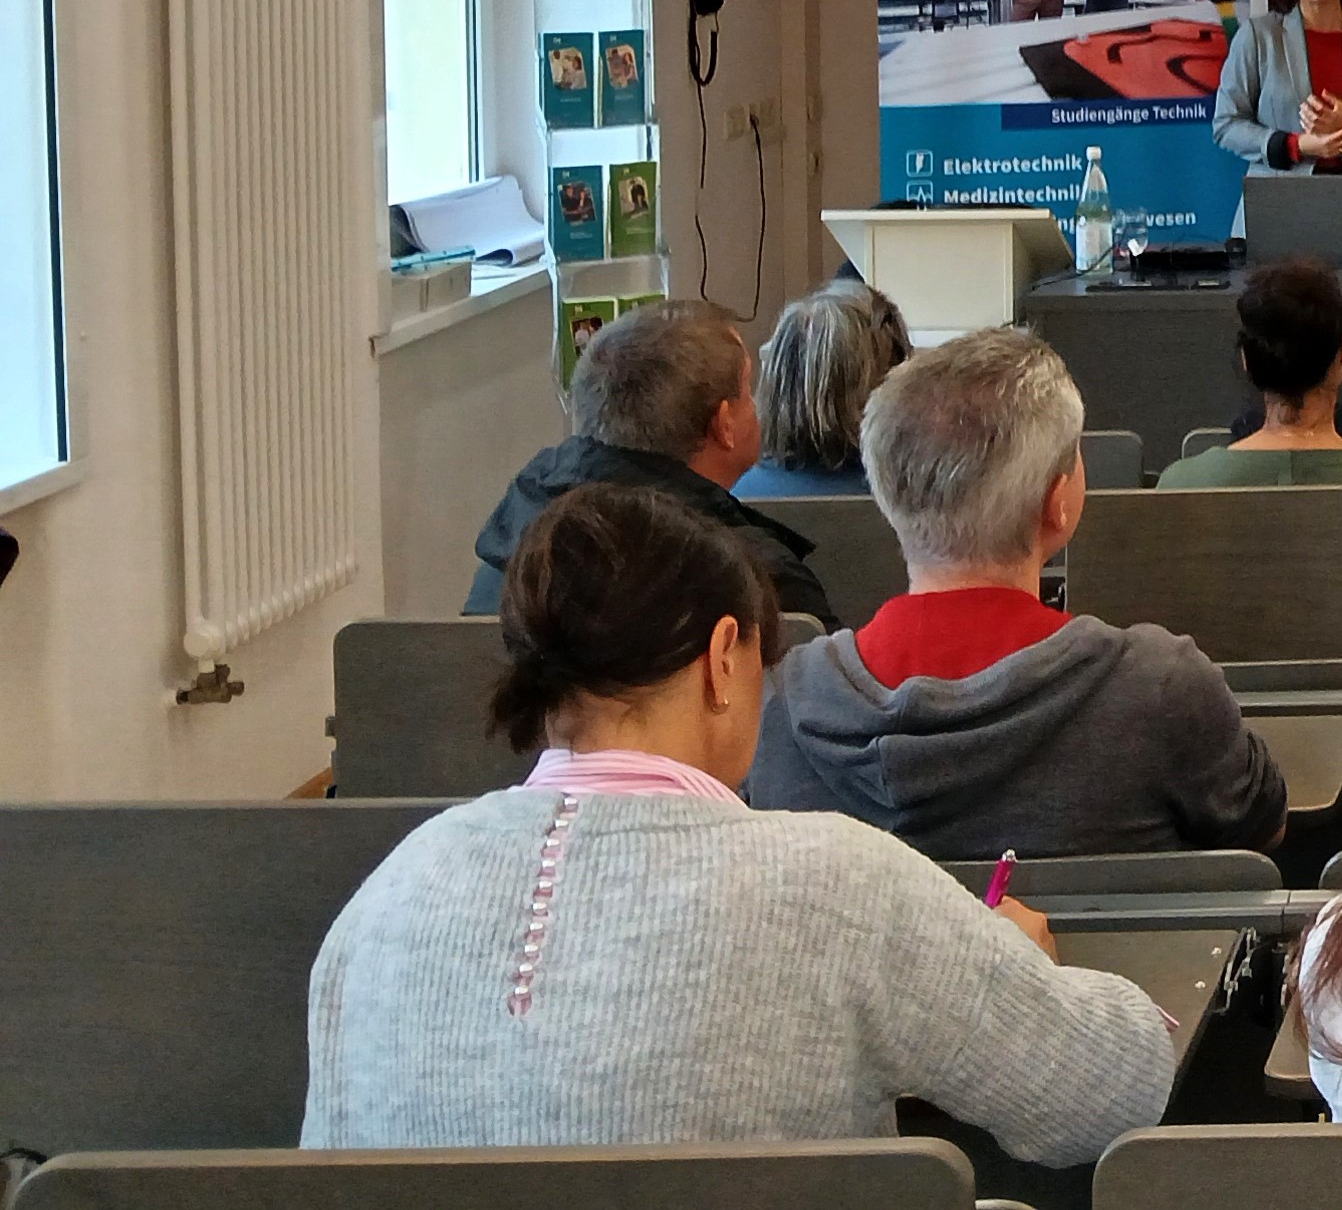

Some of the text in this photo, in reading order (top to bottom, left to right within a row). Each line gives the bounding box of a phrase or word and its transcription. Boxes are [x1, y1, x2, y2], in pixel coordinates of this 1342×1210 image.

[1051, 105, 1207, 125] Studiengänge Technik
[943, 154, 1082, 176] Elektrotechnik
